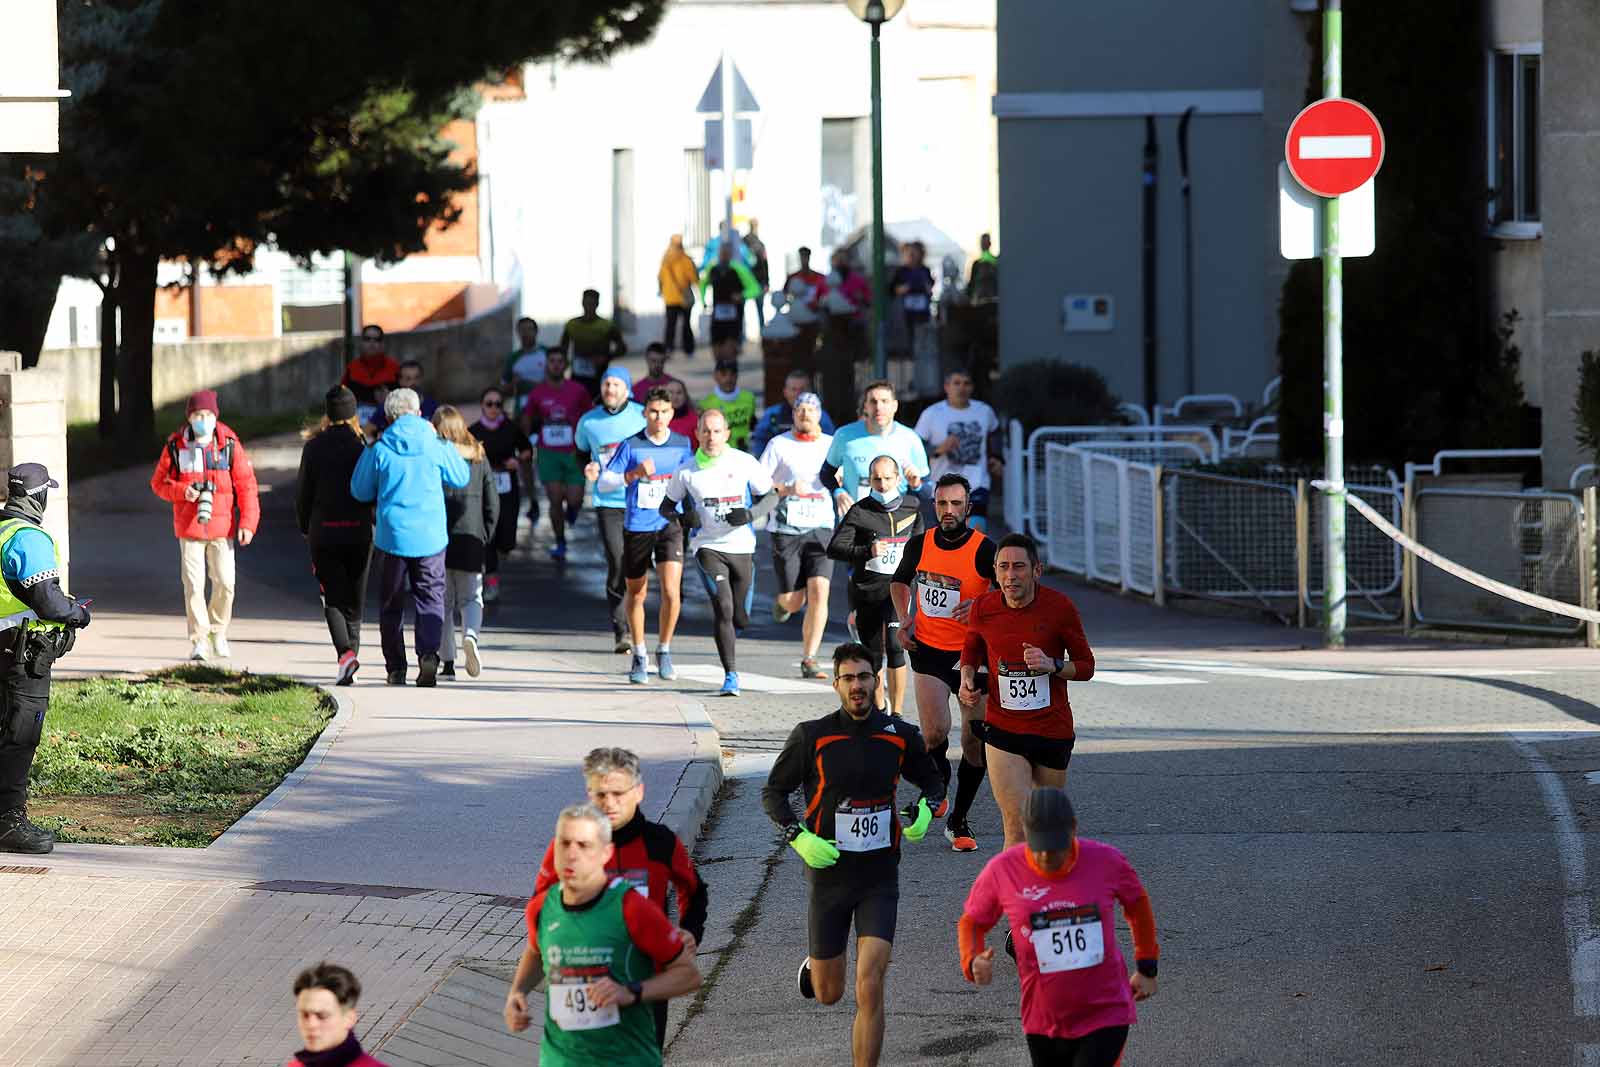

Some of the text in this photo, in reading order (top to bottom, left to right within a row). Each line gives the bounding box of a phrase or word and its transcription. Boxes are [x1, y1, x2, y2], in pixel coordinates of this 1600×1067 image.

[924, 588, 947, 607] 482
[1009, 679, 1037, 698] 534
[850, 815, 879, 838] 496
[1052, 928, 1087, 955] 516
